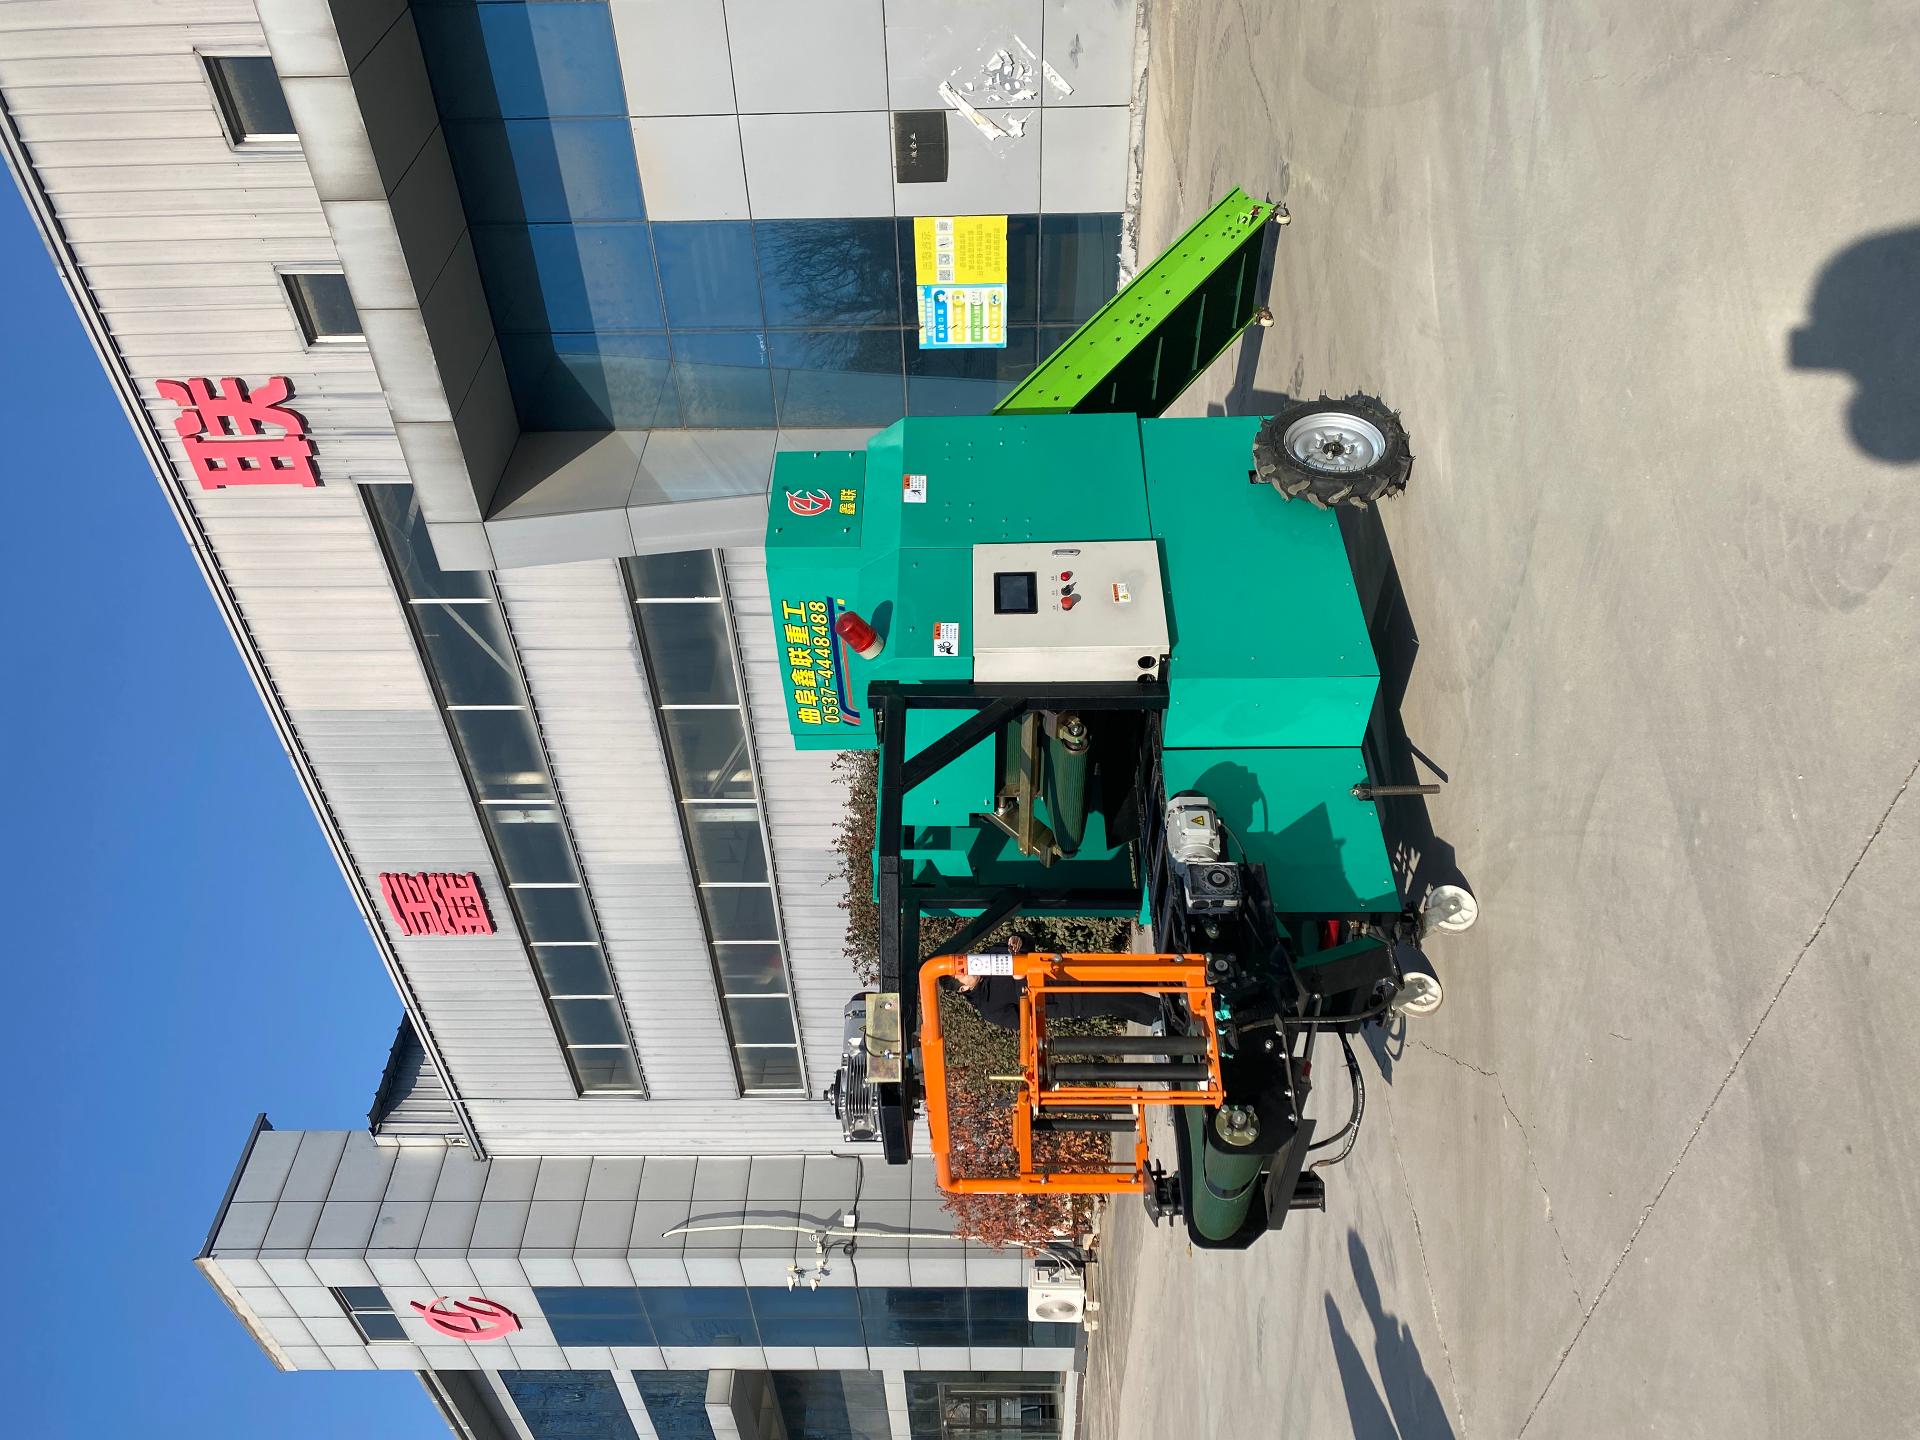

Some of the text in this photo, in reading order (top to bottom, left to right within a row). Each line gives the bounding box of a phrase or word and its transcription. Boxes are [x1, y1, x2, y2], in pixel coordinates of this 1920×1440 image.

[839, 489, 857, 515] 鑫联
[155, 376, 494, 936] 鑫 联
[781, 600, 822, 724] 曲阜鑫联重工
[808, 601, 840, 724] 0537-4448488
